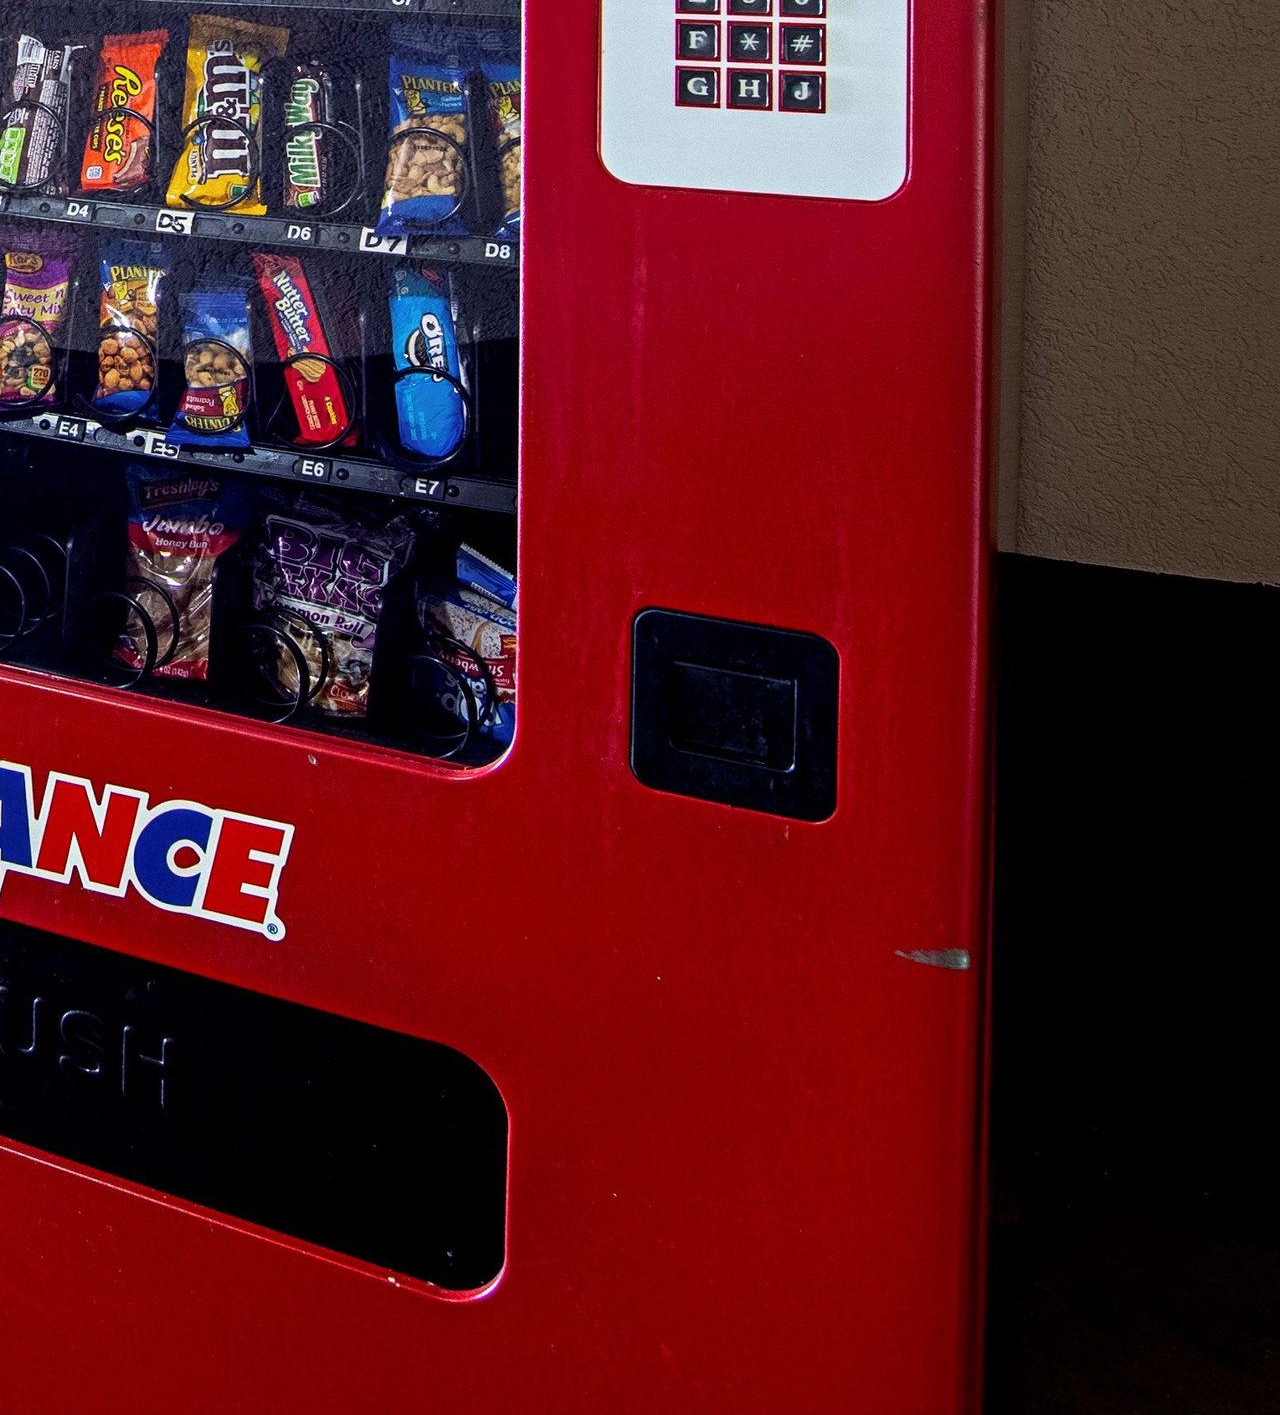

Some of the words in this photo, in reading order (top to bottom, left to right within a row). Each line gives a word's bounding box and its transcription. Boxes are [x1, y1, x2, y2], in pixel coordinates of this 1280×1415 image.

[285, 78, 319, 126] Way
[67, 202, 89, 218] D4
[287, 226, 312, 240] D6
[485, 243, 511, 260] D8
[4, 288, 50, 304] Sweet
[273, 270, 308, 317] Nutter
[41, 303, 65, 315] Mix
[275, 296, 311, 343] Butter
[33, 367, 49, 377] 270
[186, 395, 215, 407] Peanuts
[58, 421, 79, 437] E4
[301, 461, 325, 476] E6
[414, 479, 439, 495] E7
[142, 513, 224, 536] Jumbo
[154, 536, 184, 549] Honey
[184, 539, 208, 550] Bun
[266, 514, 393, 586] BIG
[333, 616, 365, 636] Roll
